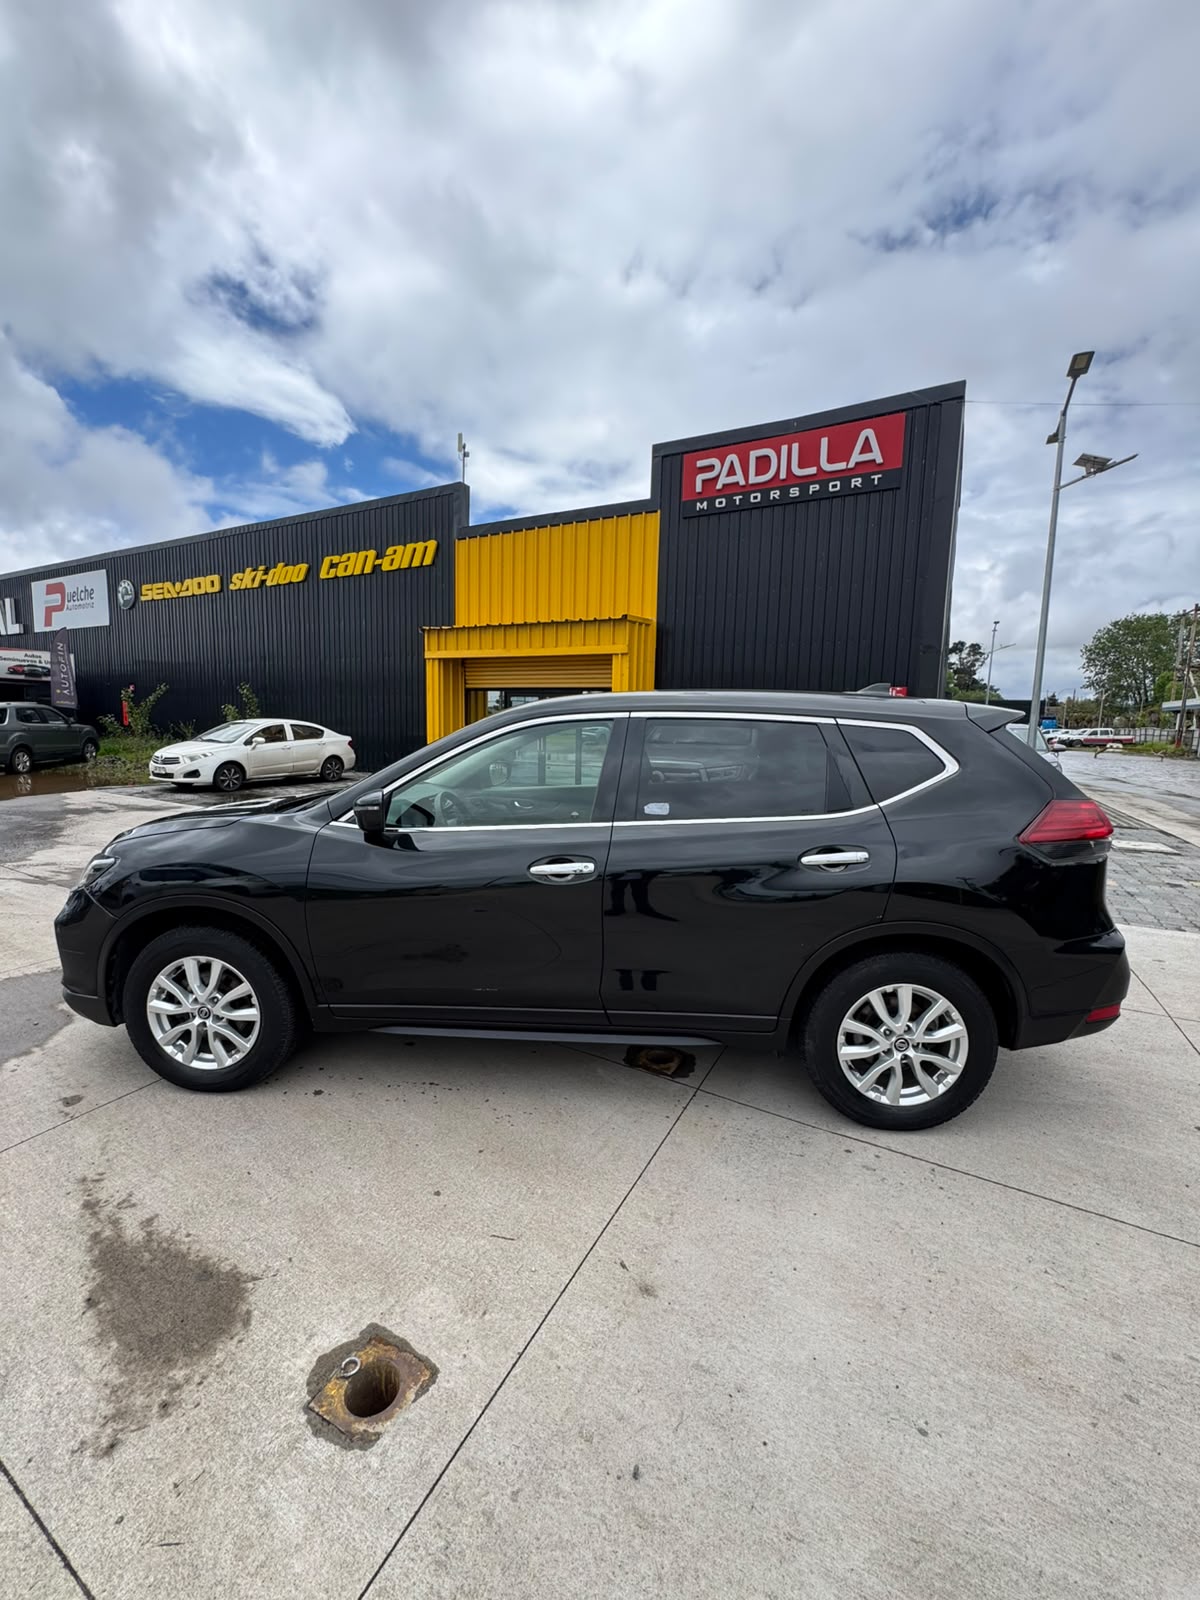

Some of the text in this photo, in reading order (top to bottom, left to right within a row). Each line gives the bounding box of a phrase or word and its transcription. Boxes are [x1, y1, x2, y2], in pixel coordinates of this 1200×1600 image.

[695, 428, 884, 493] PADILLA
[696, 474, 883, 511] MOTORSPORT
[319, 539, 438, 580] can-am
[66, 602, 95, 611] Automotriz
